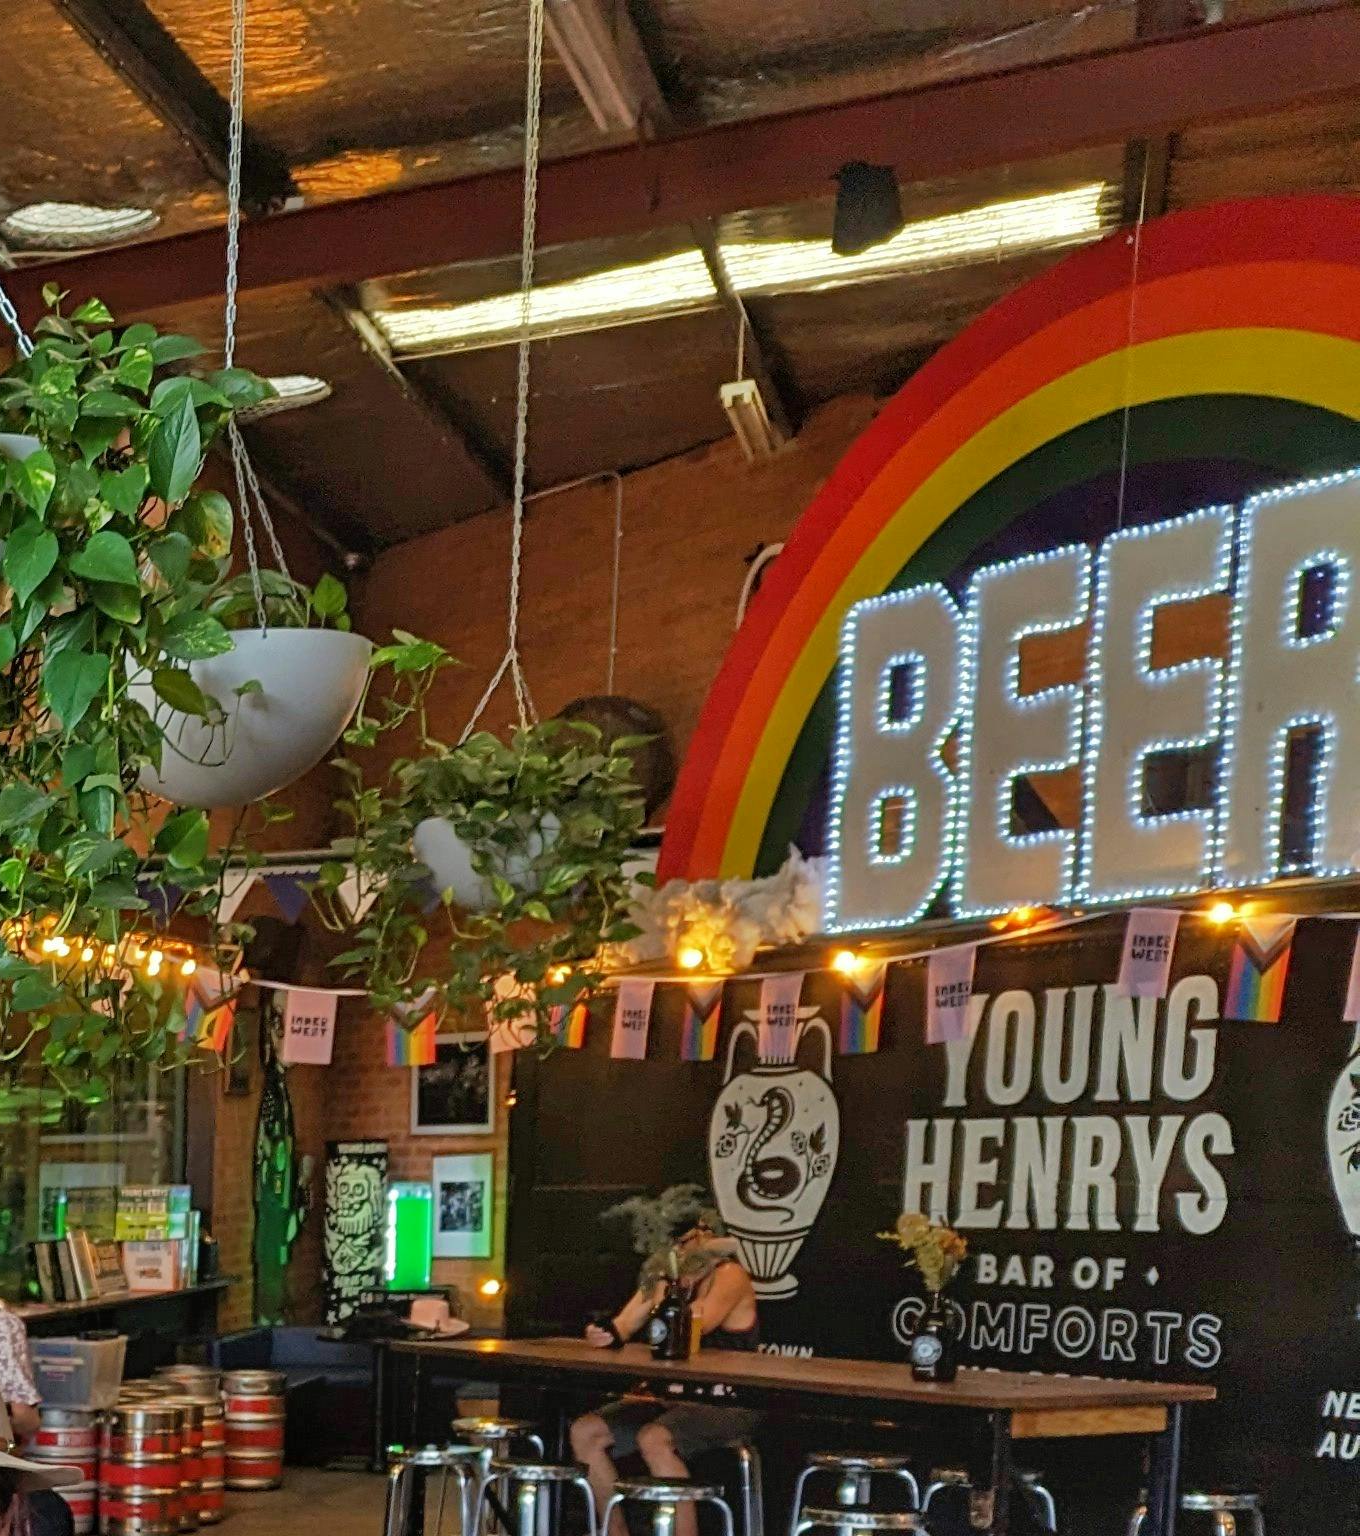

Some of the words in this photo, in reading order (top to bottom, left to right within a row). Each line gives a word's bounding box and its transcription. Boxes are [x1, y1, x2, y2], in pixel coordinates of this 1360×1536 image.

[824, 466, 1360, 934] BEER
[940, 973, 1221, 1108] YOUNG
[904, 1111, 1235, 1236] HENRYS
[978, 1255, 1055, 1288] BAR
[1073, 1257, 1127, 1292] OF
